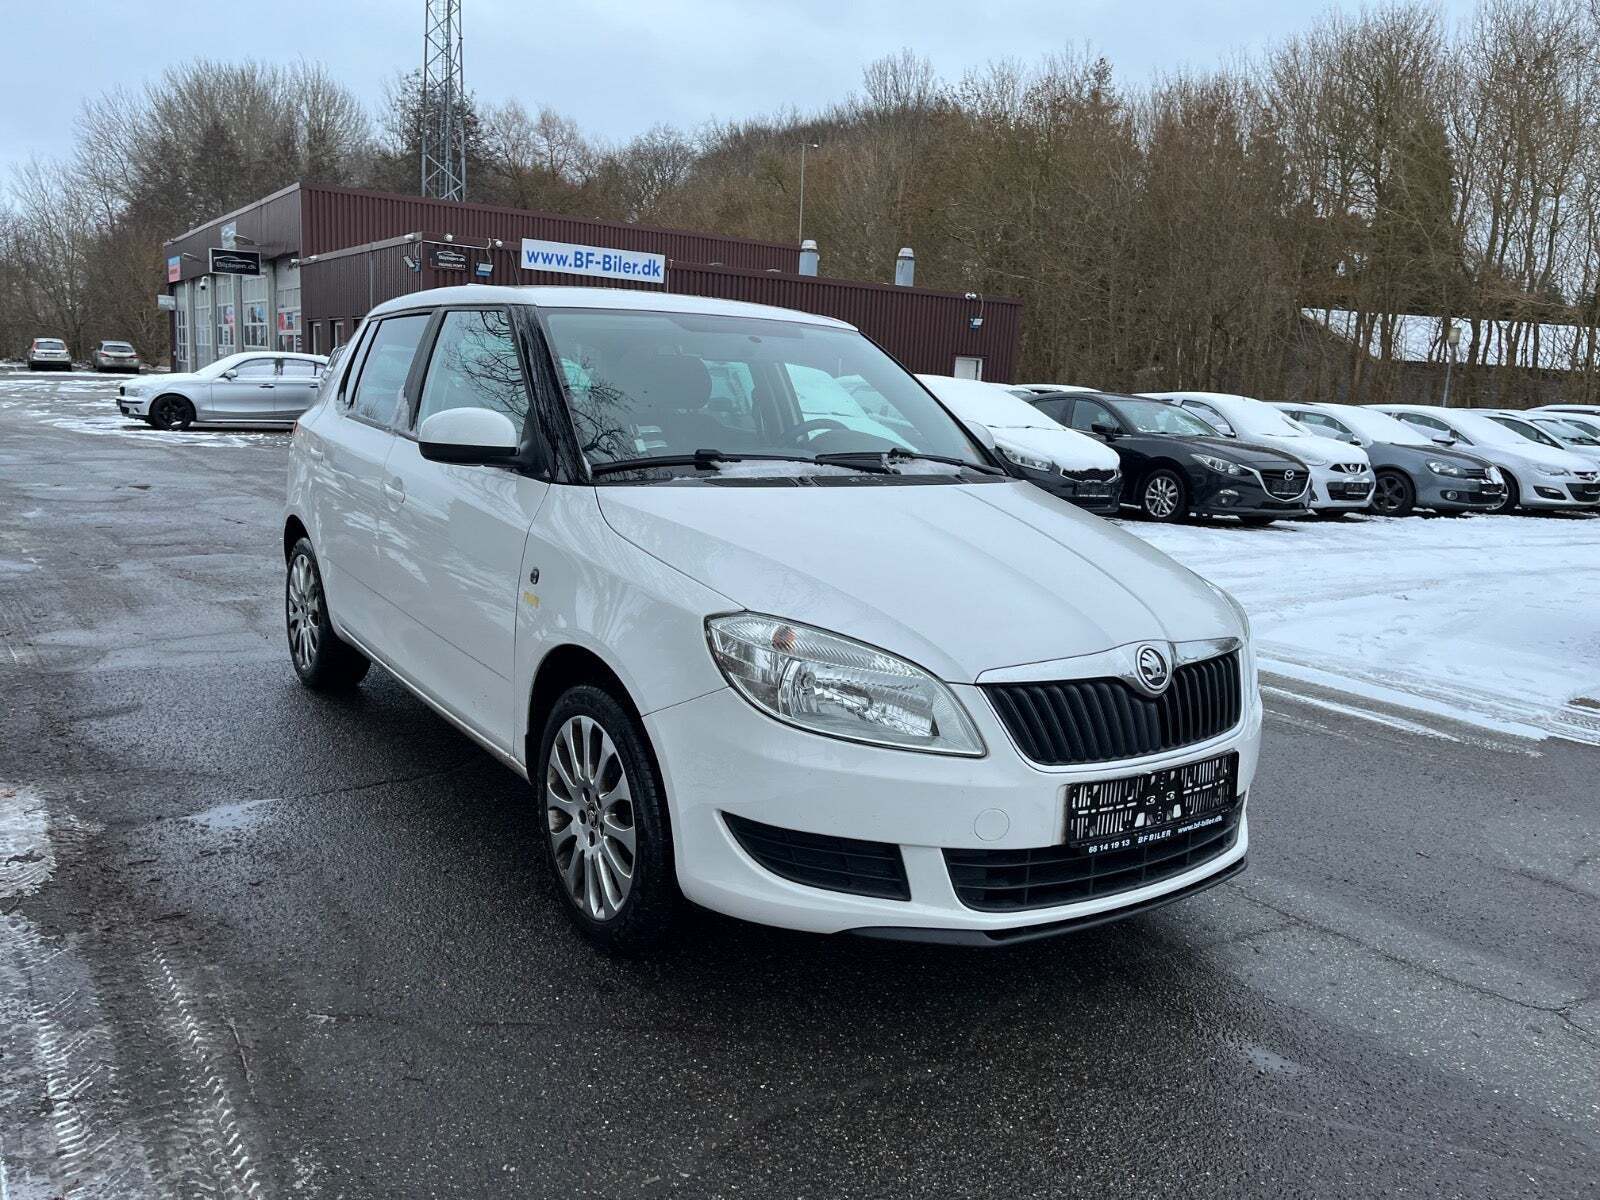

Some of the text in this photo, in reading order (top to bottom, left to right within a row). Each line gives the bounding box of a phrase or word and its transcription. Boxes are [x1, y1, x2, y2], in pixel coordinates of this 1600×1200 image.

[526, 250, 661, 277] www.BF-Biler.dk
[1099, 843, 1109, 851] 14
[1110, 841, 1120, 849] 19
[1121, 839, 1130, 847] 13
[1137, 835, 1149, 844] BF
[1149, 829, 1172, 842] BILER
